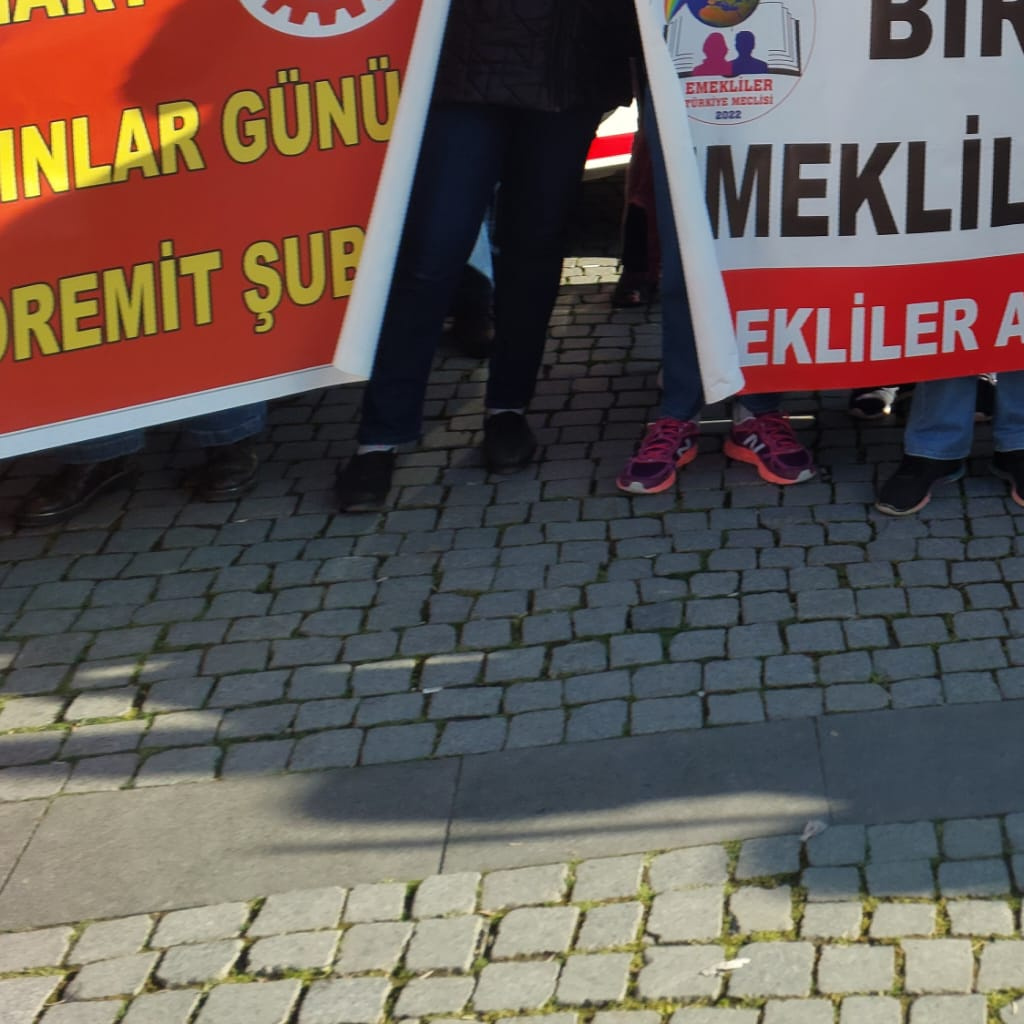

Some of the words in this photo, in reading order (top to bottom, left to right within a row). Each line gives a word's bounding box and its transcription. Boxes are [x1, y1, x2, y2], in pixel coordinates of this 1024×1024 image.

[684, 96, 729, 108] TÜRKİYE
[731, 94, 774, 106] MECLİSİ
[685, 77, 773, 95] EMEKLİLER
[221, 55, 402, 165] GÜNÜ
[714, 110, 742, 120] 2022
[0, 239, 222, 364] REMİT
[737, 292, 979, 367] EKLİLER
